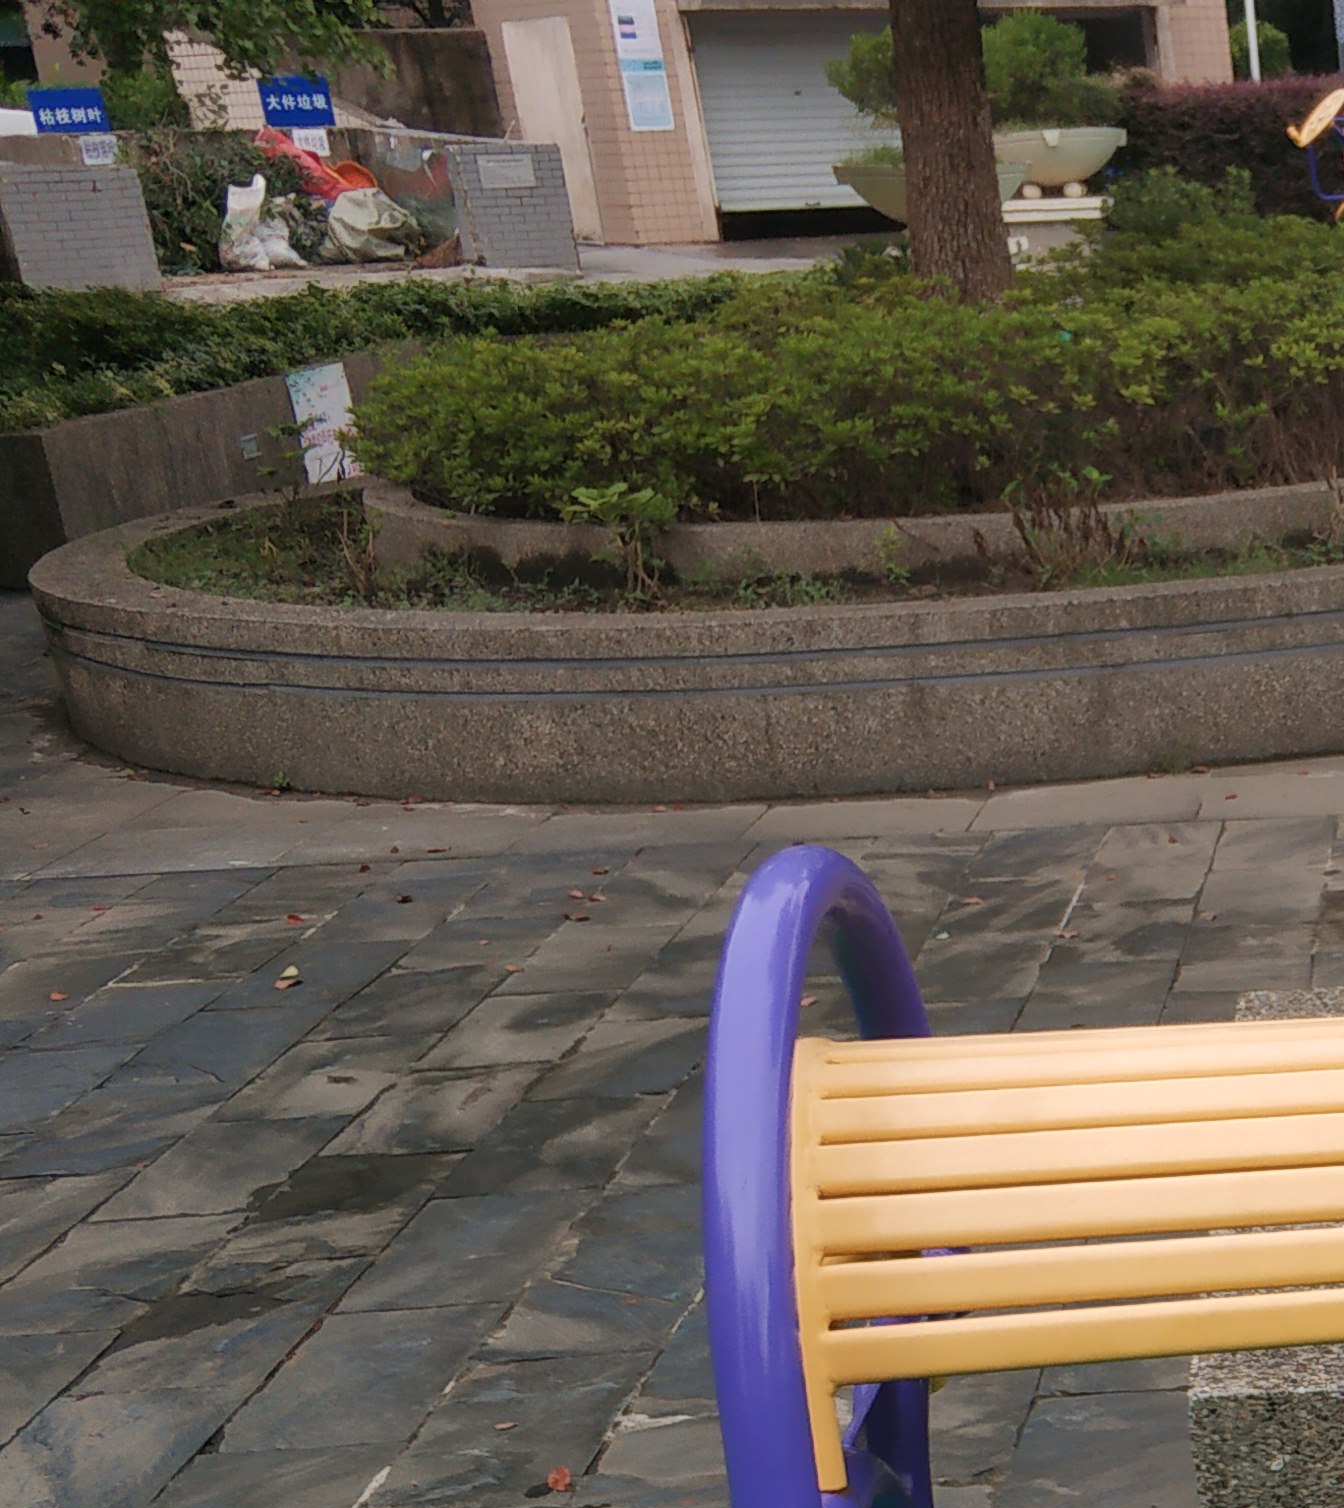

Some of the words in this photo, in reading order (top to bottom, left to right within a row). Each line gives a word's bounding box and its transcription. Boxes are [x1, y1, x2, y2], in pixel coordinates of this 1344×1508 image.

[265, 93, 329, 111] 大件垃圾
[38, 106, 102, 126] 枯枝树叶
